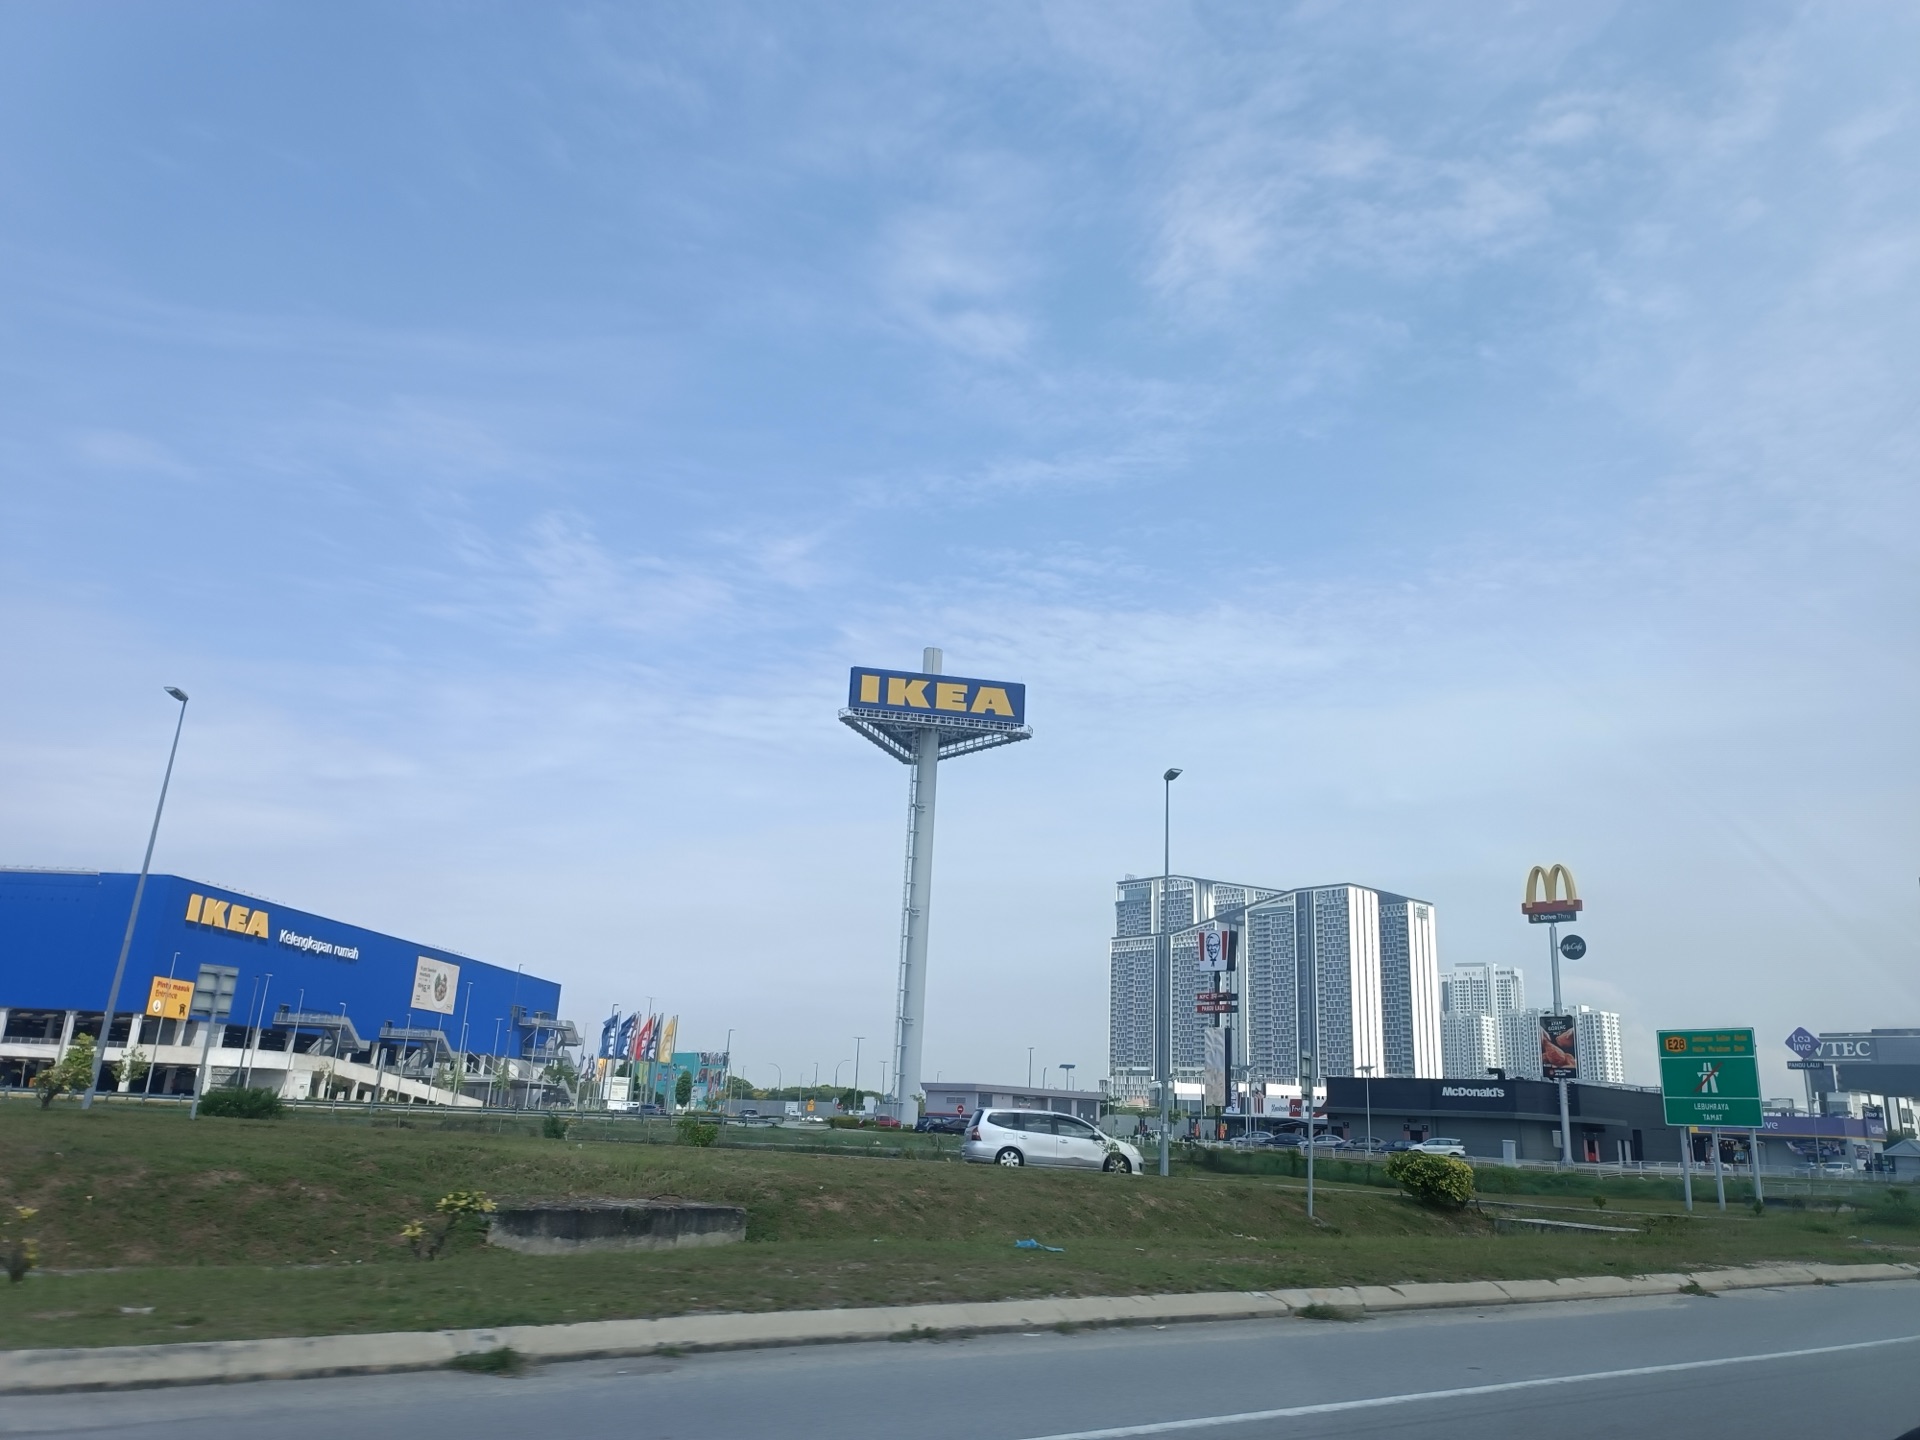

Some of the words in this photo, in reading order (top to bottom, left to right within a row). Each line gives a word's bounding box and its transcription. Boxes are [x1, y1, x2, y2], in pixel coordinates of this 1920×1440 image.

[860, 674, 1015, 717] IKEA
[185, 893, 269, 939] IKEA
[279, 929, 333, 954] Kelengkapan
[333, 946, 359, 961] rumah
[172, 983, 190, 993] masuk
[1792, 1034, 1811, 1043] tea
[1667, 1039, 1685, 1050] E28
[1793, 1043, 1812, 1051] live
[1441, 1086, 1505, 1098] McDonald's
[1693, 1103, 1730, 1111] LEBUHRAYA
